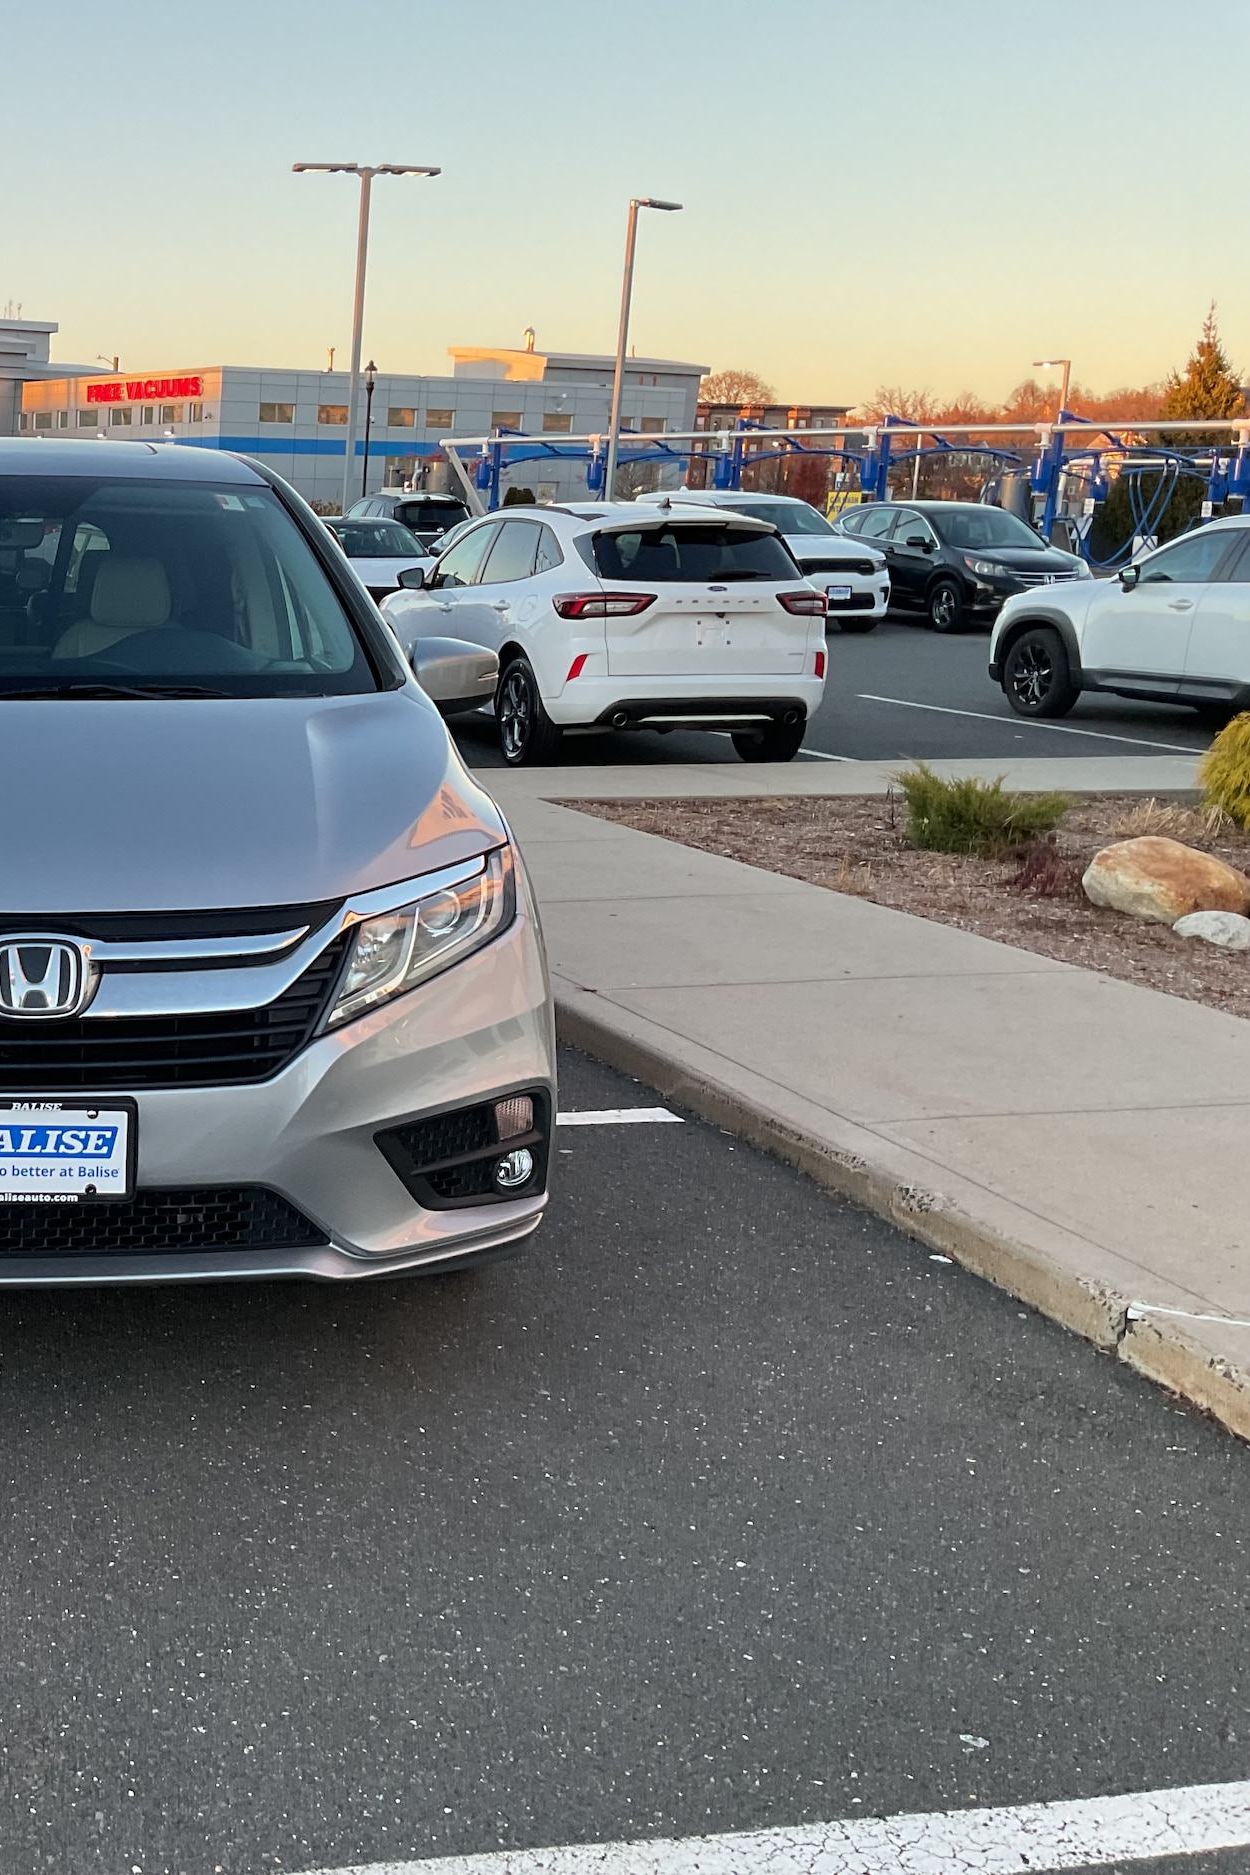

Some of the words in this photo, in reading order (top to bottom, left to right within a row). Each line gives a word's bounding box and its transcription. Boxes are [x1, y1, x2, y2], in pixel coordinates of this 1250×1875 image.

[87, 383, 123, 403] FREE
[126, 376, 202, 401] VACUUMS
[11, 1102, 63, 1112] BALISE
[11, 1165, 56, 1177] better
[59, 1167, 74, 1177] at
[78, 1166, 119, 1178] Balise
